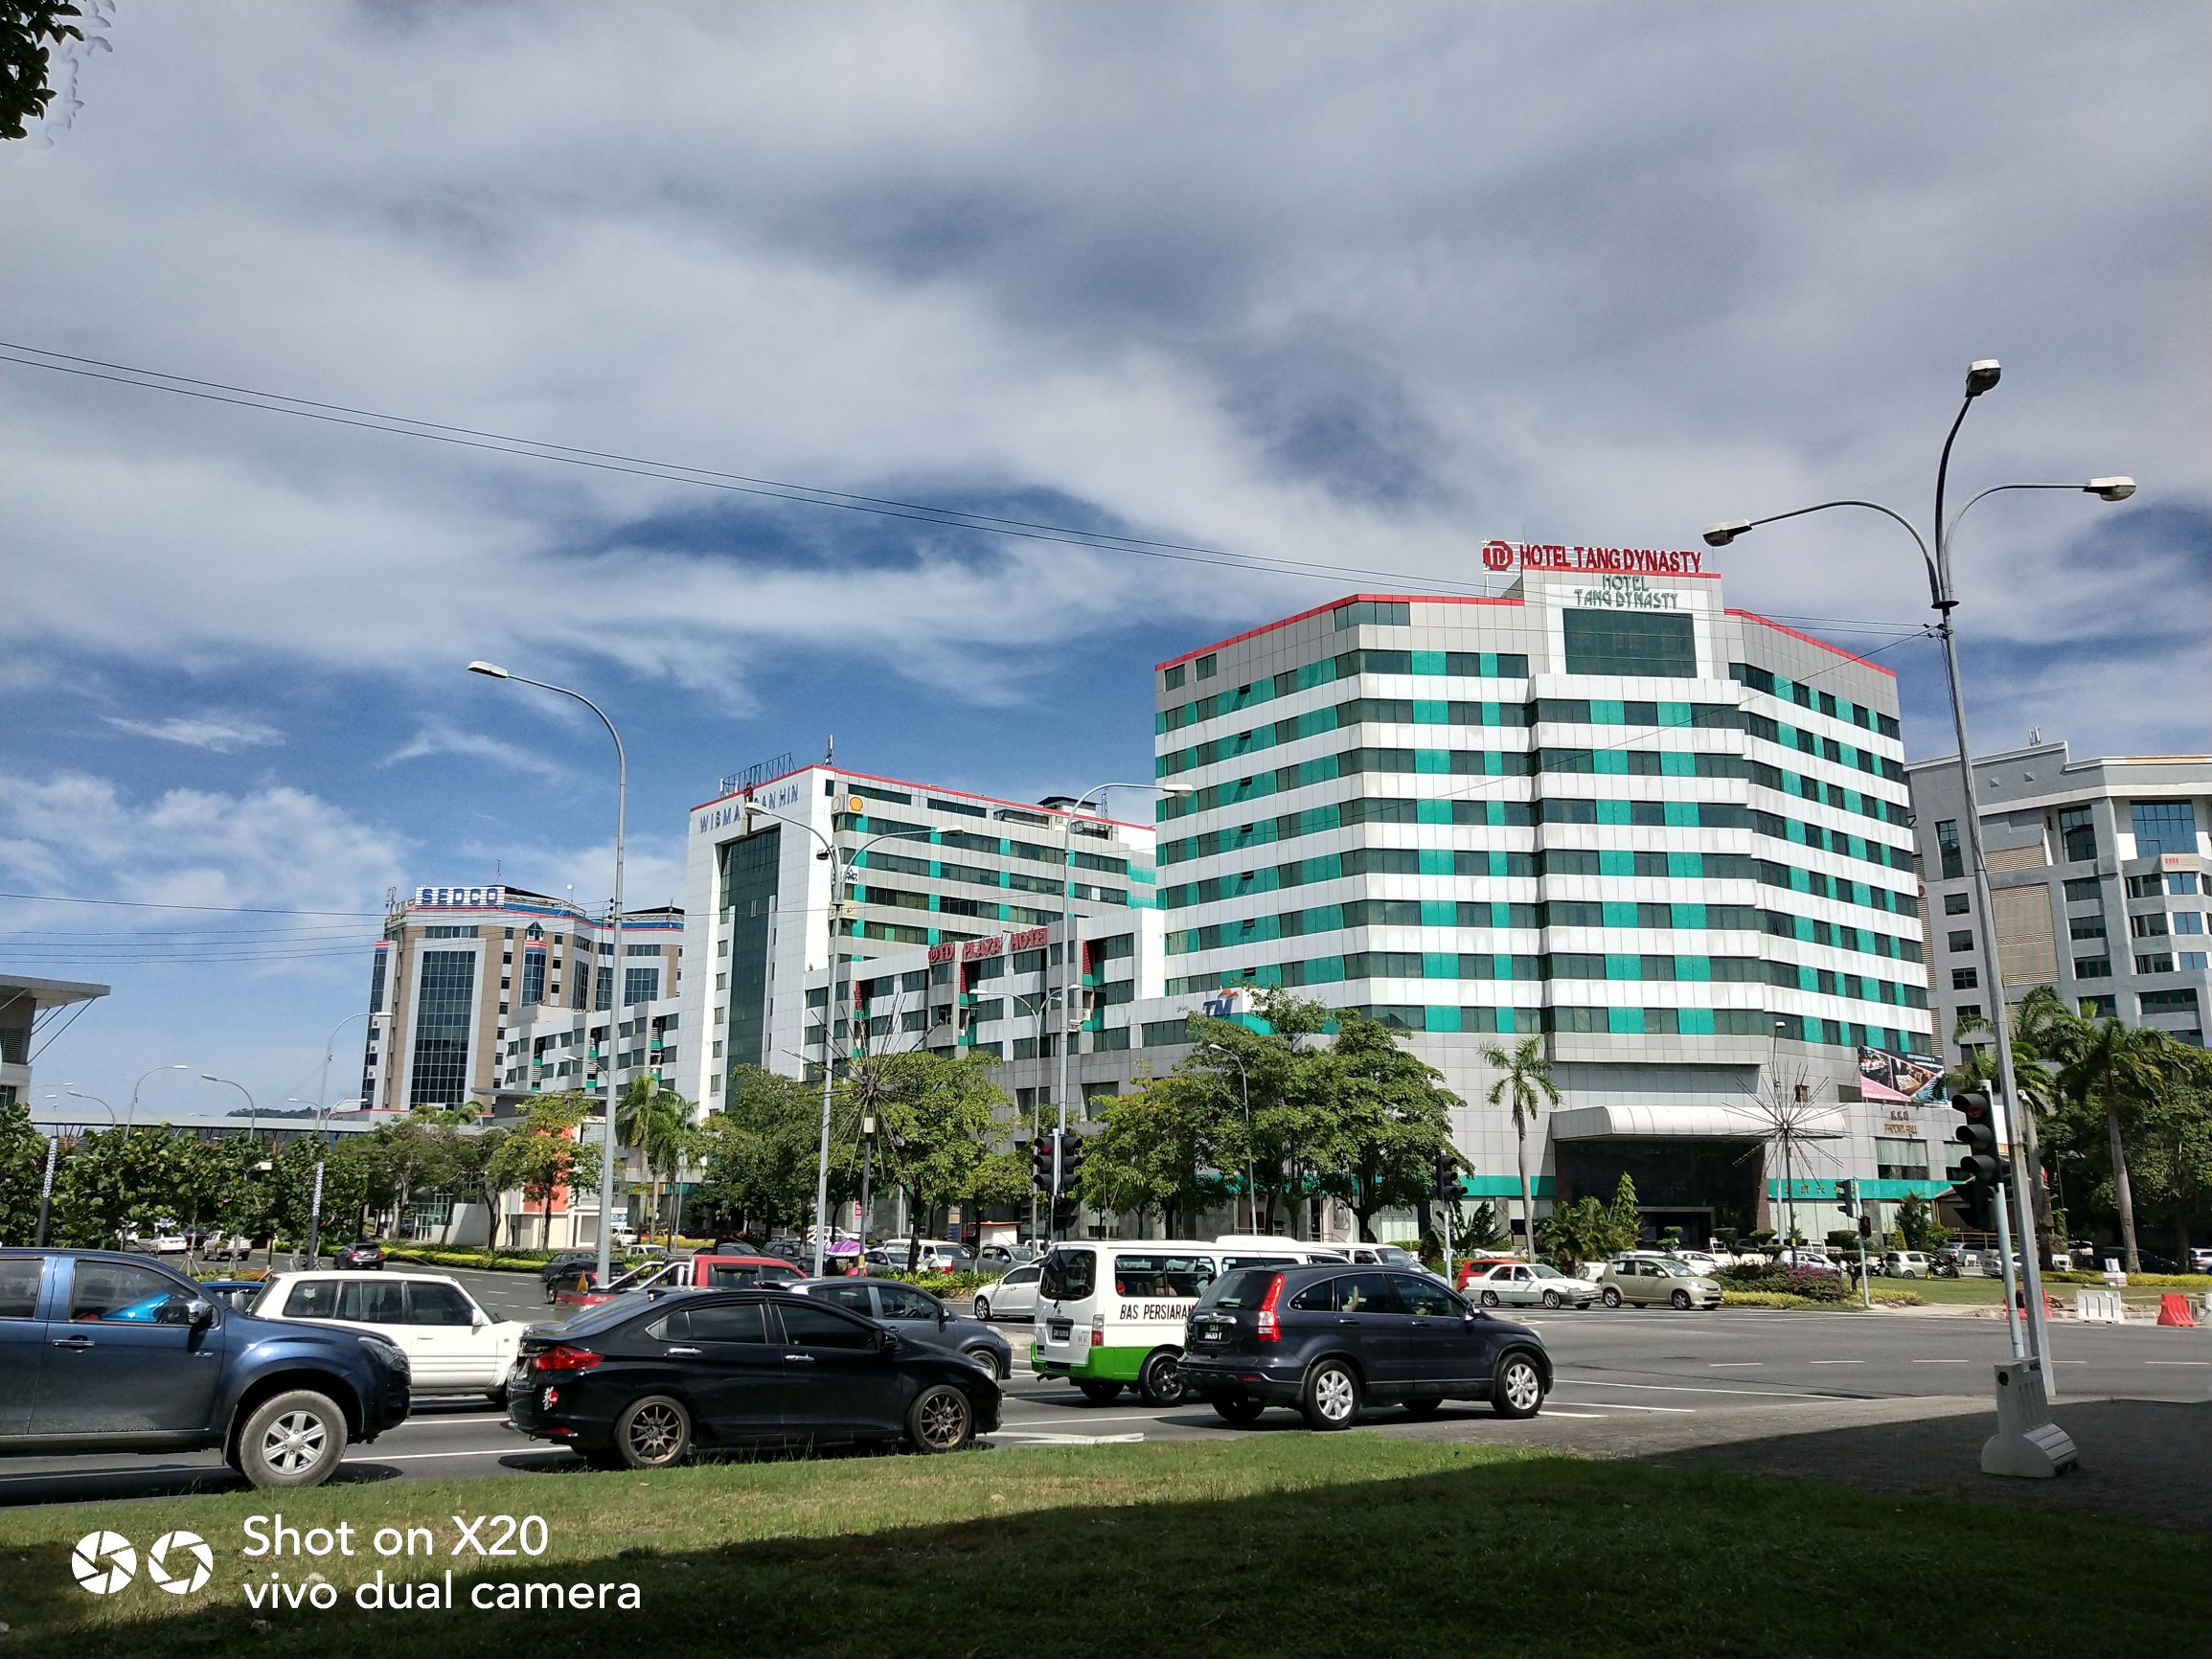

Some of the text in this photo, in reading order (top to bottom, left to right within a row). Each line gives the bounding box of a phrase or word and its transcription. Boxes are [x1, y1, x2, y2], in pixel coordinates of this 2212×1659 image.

[1520, 544, 1571, 567] HOTEL
[1603, 575, 1650, 591] HOTEL
[1574, 588, 1678, 609] TANG DYNASTY
[700, 805, 741, 834] WISMA
[422, 888, 498, 905] SEDCO
[963, 937, 1002, 960] PLAZA
[1203, 999, 1233, 1016] TM
[1120, 1304, 1139, 1320] BAS
